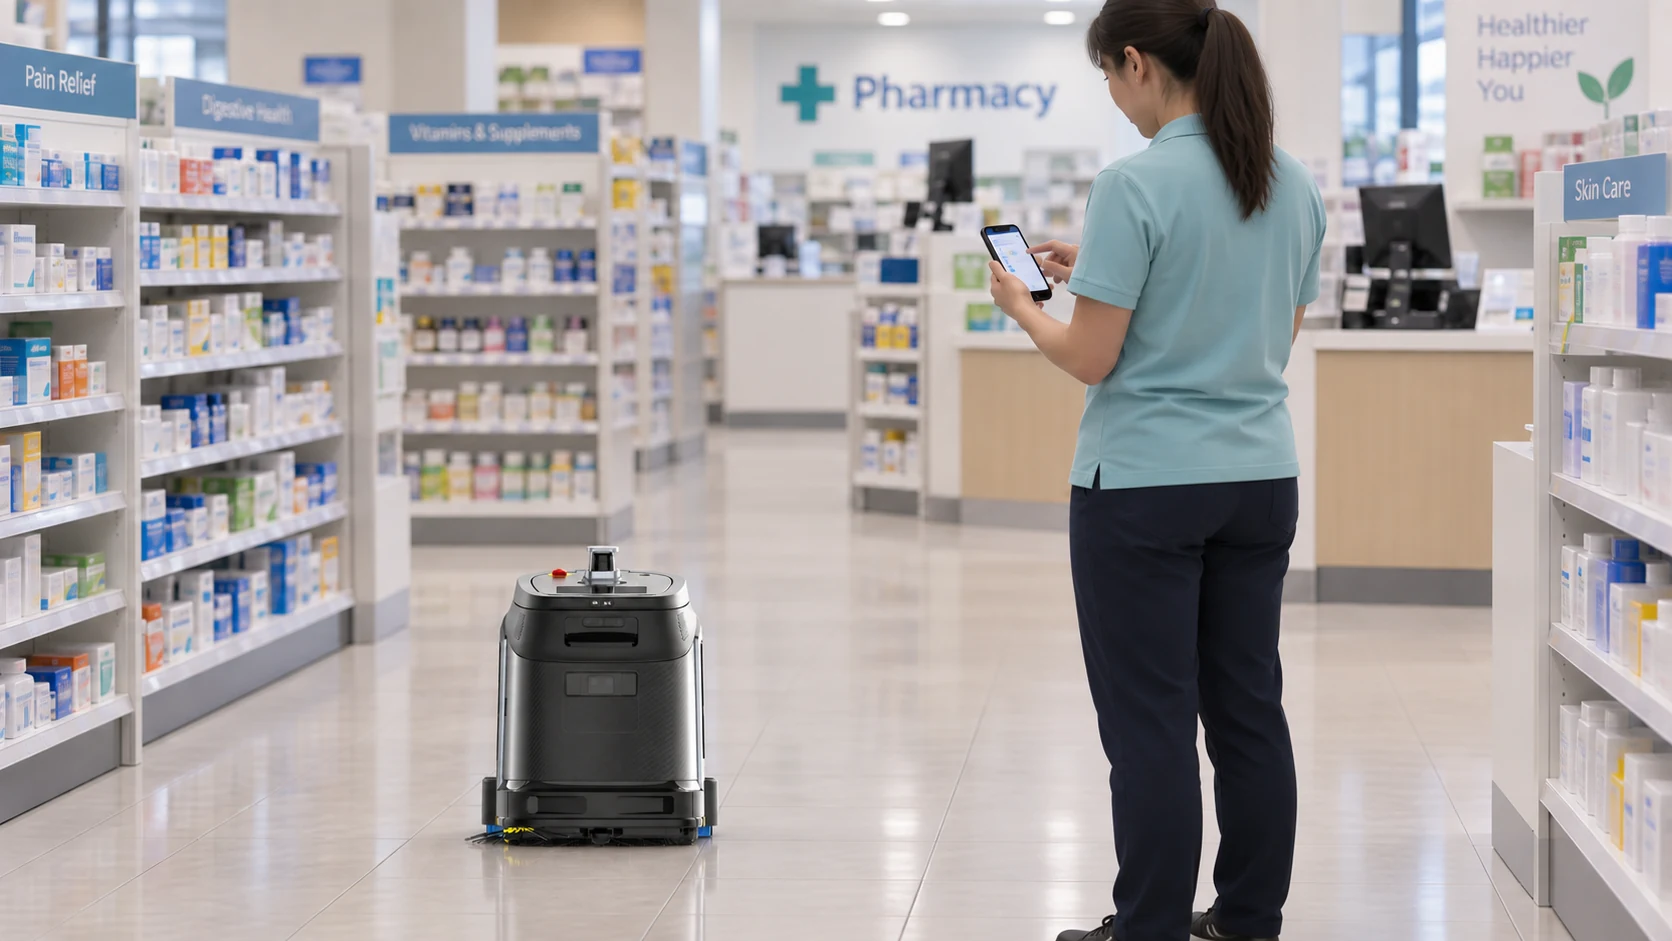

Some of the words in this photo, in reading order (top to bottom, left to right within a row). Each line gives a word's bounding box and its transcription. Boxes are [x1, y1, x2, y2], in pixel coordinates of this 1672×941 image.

[1477, 12, 1589, 37] Healthier
[1477, 45, 1574, 74] Happier
[25, 64, 55, 91] Pain
[59, 69, 97, 96] Relief
[1476, 79, 1525, 102] You
[202, 93, 254, 121] Digestive
[256, 102, 293, 125] Health
[854, 74, 1057, 118] Pharmacy
[409, 123, 472, 142] Vitamins
[474, 122, 486, 142] &
[488, 122, 581, 145] Supplements
[1575, 179, 1600, 201] Skin
[1602, 176, 1631, 199] Care
